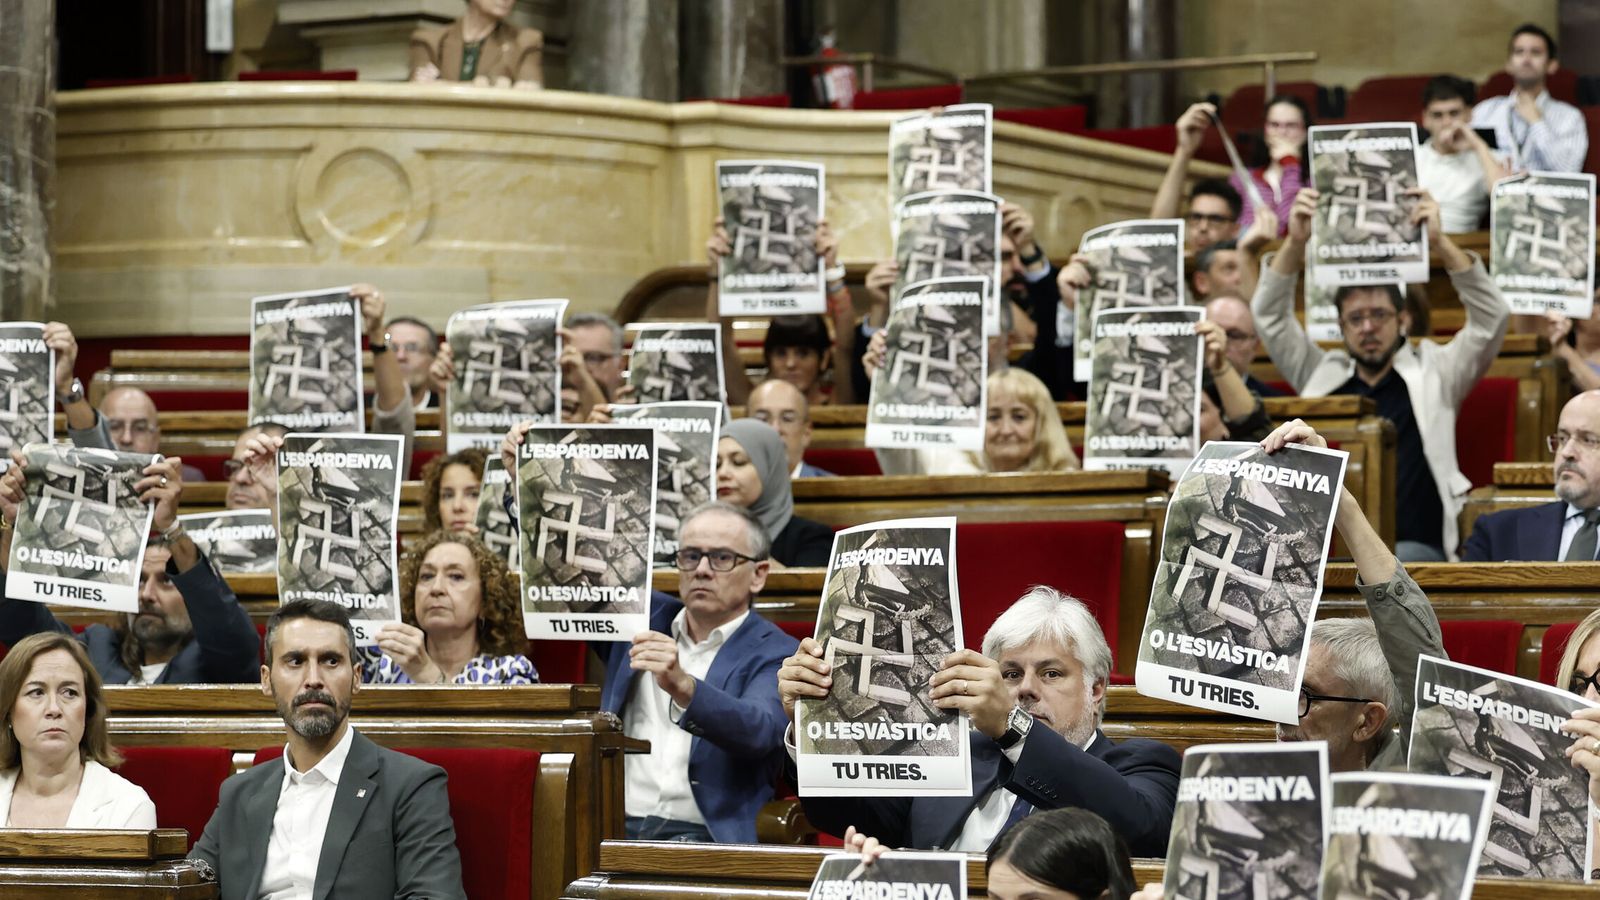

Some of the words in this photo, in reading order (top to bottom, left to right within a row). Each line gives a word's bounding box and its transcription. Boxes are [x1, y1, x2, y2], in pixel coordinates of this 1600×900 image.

[1339, 269, 1356, 280] TU
[892, 430, 908, 442] TU
[280, 451, 393, 470] L'ESPARDENYA
[521, 443, 650, 460] L'ESPARDENYA
[1192, 458, 1331, 495] L'ESPARDENYA
[16, 547, 29, 562] O
[30, 547, 130, 575] L'ESVÀSTICA
[833, 547, 945, 570] L'ESPARDENYA
[33, 581, 54, 596] TU
[57, 584, 107, 603] TRIES.
[527, 586, 540, 602] O
[541, 581, 640, 603] L'ESVÀSTICA
[549, 620, 569, 633] TU
[572, 620, 619, 634] TRIES.
[1149, 629, 1164, 648] O
[1166, 631, 1290, 675] L'ESVÀSTICA
[1168, 675, 1195, 697] TU
[1198, 678, 1260, 710] TRIES.
[807, 721, 822, 740] O
[825, 716, 952, 741] L'ESVÀSTICA
[832, 762, 859, 779] TU
[862, 763, 928, 781] TRIES.
